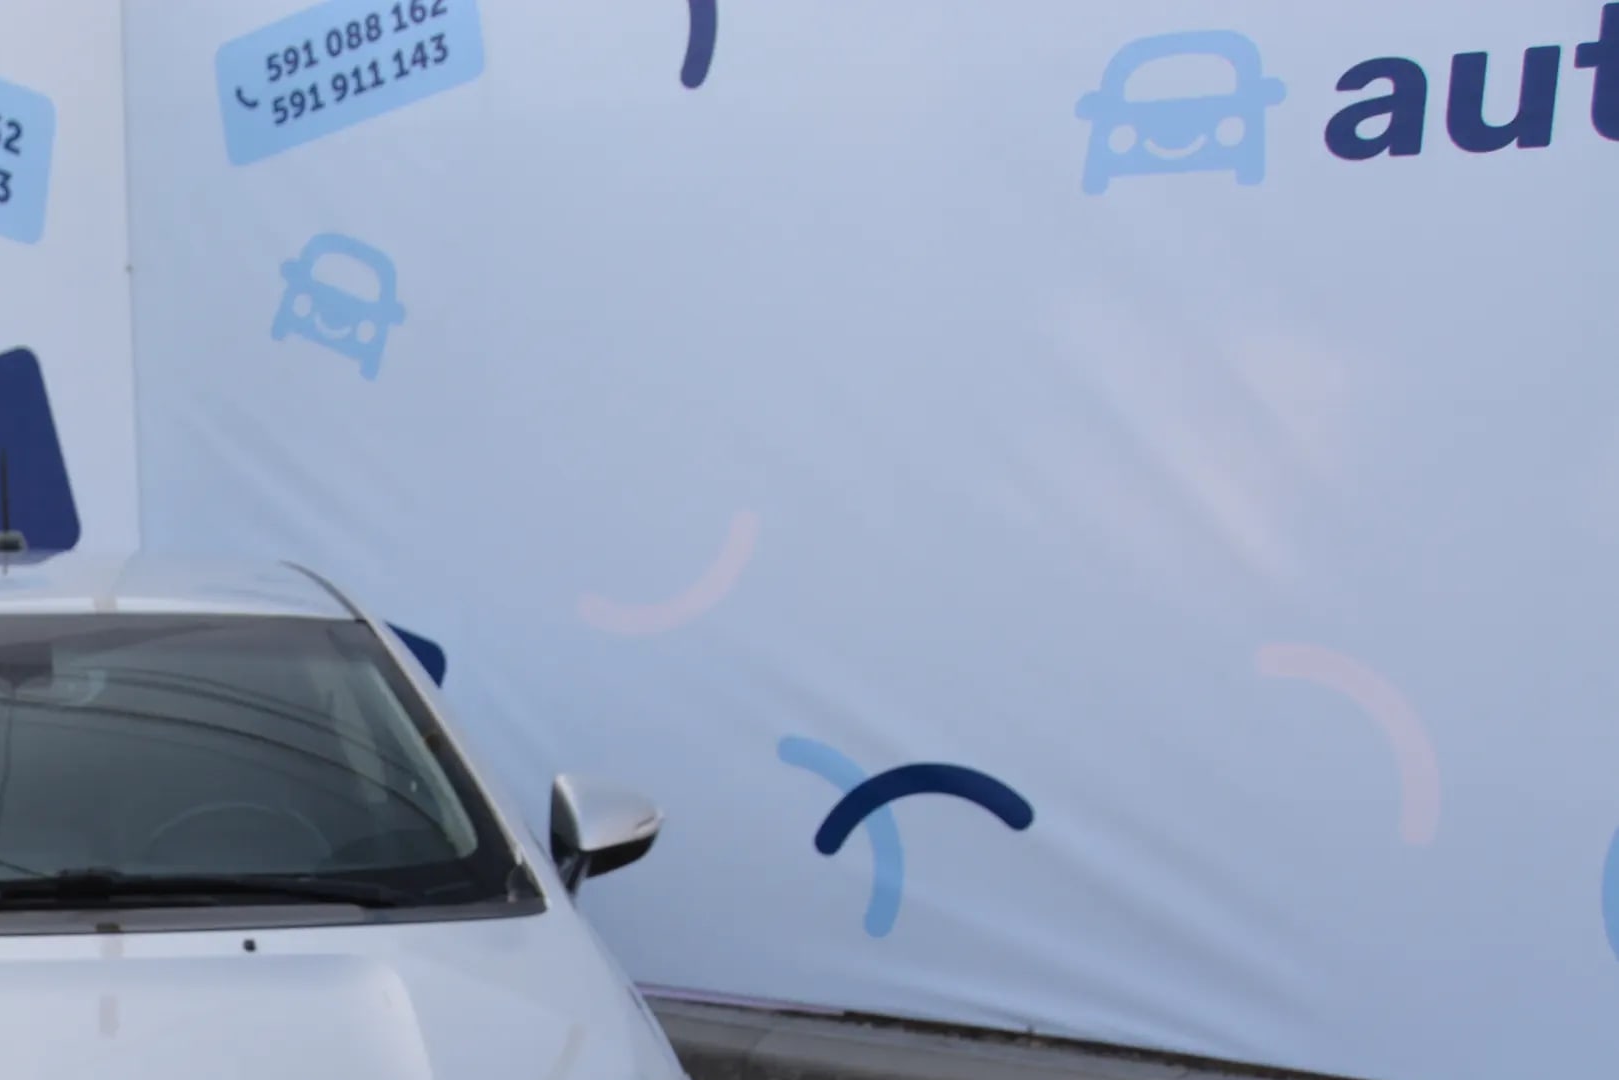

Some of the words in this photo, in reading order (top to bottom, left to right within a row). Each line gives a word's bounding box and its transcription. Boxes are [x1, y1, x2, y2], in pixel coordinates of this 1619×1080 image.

[266, 40, 318, 82] 591
[325, 12, 383, 58] 088
[271, 83, 325, 126] 591
[331, 60, 385, 102] 911
[392, 33, 449, 79] 143
